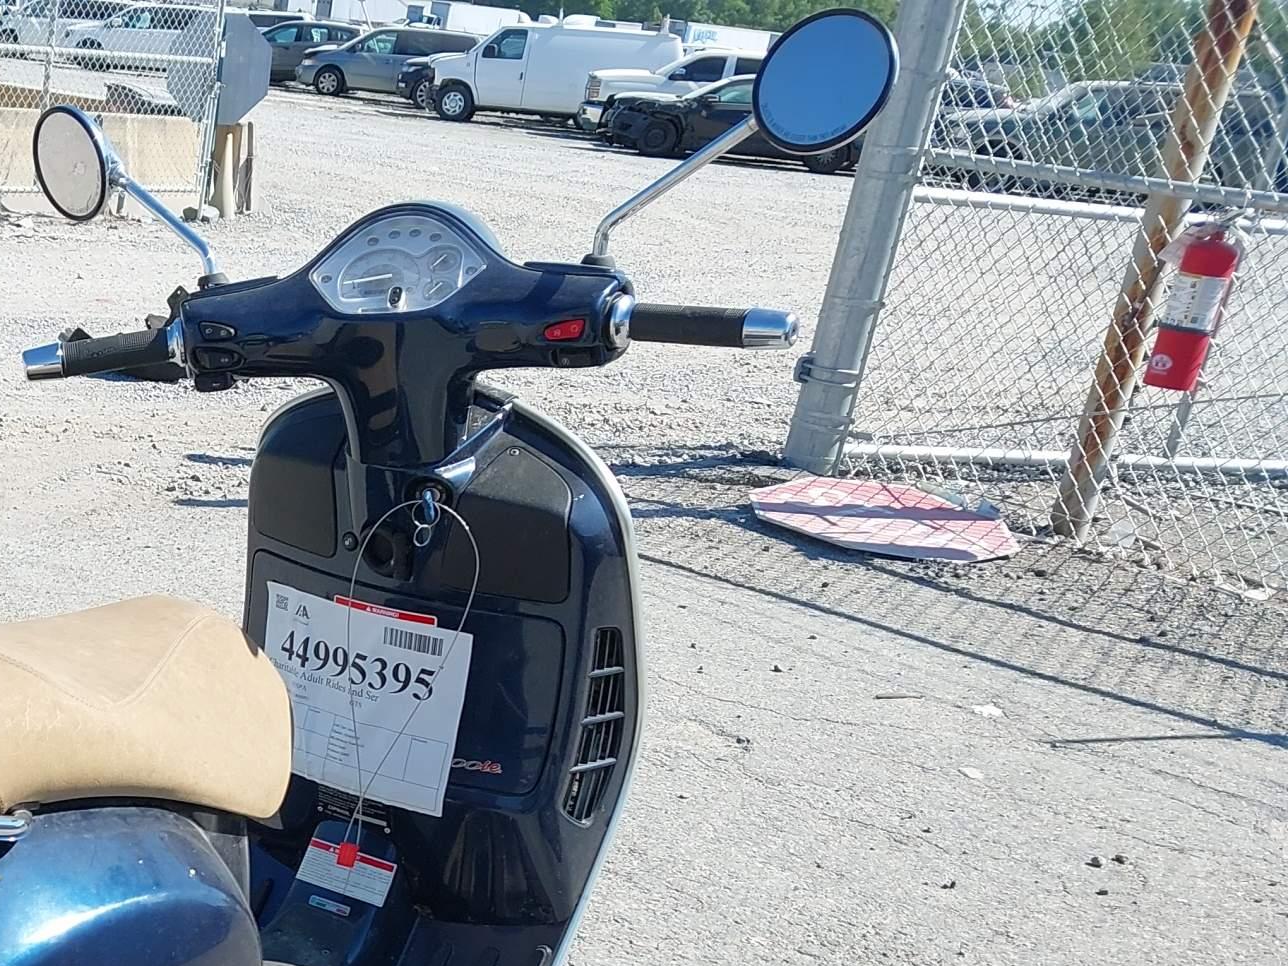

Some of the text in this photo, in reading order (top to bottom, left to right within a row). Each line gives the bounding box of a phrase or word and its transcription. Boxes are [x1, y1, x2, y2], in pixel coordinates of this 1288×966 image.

[281, 630, 436, 701] 44995395
[300, 671, 324, 685] Adult
[325, 678, 346, 693] Rides
[365, 690, 380, 702] Ser
